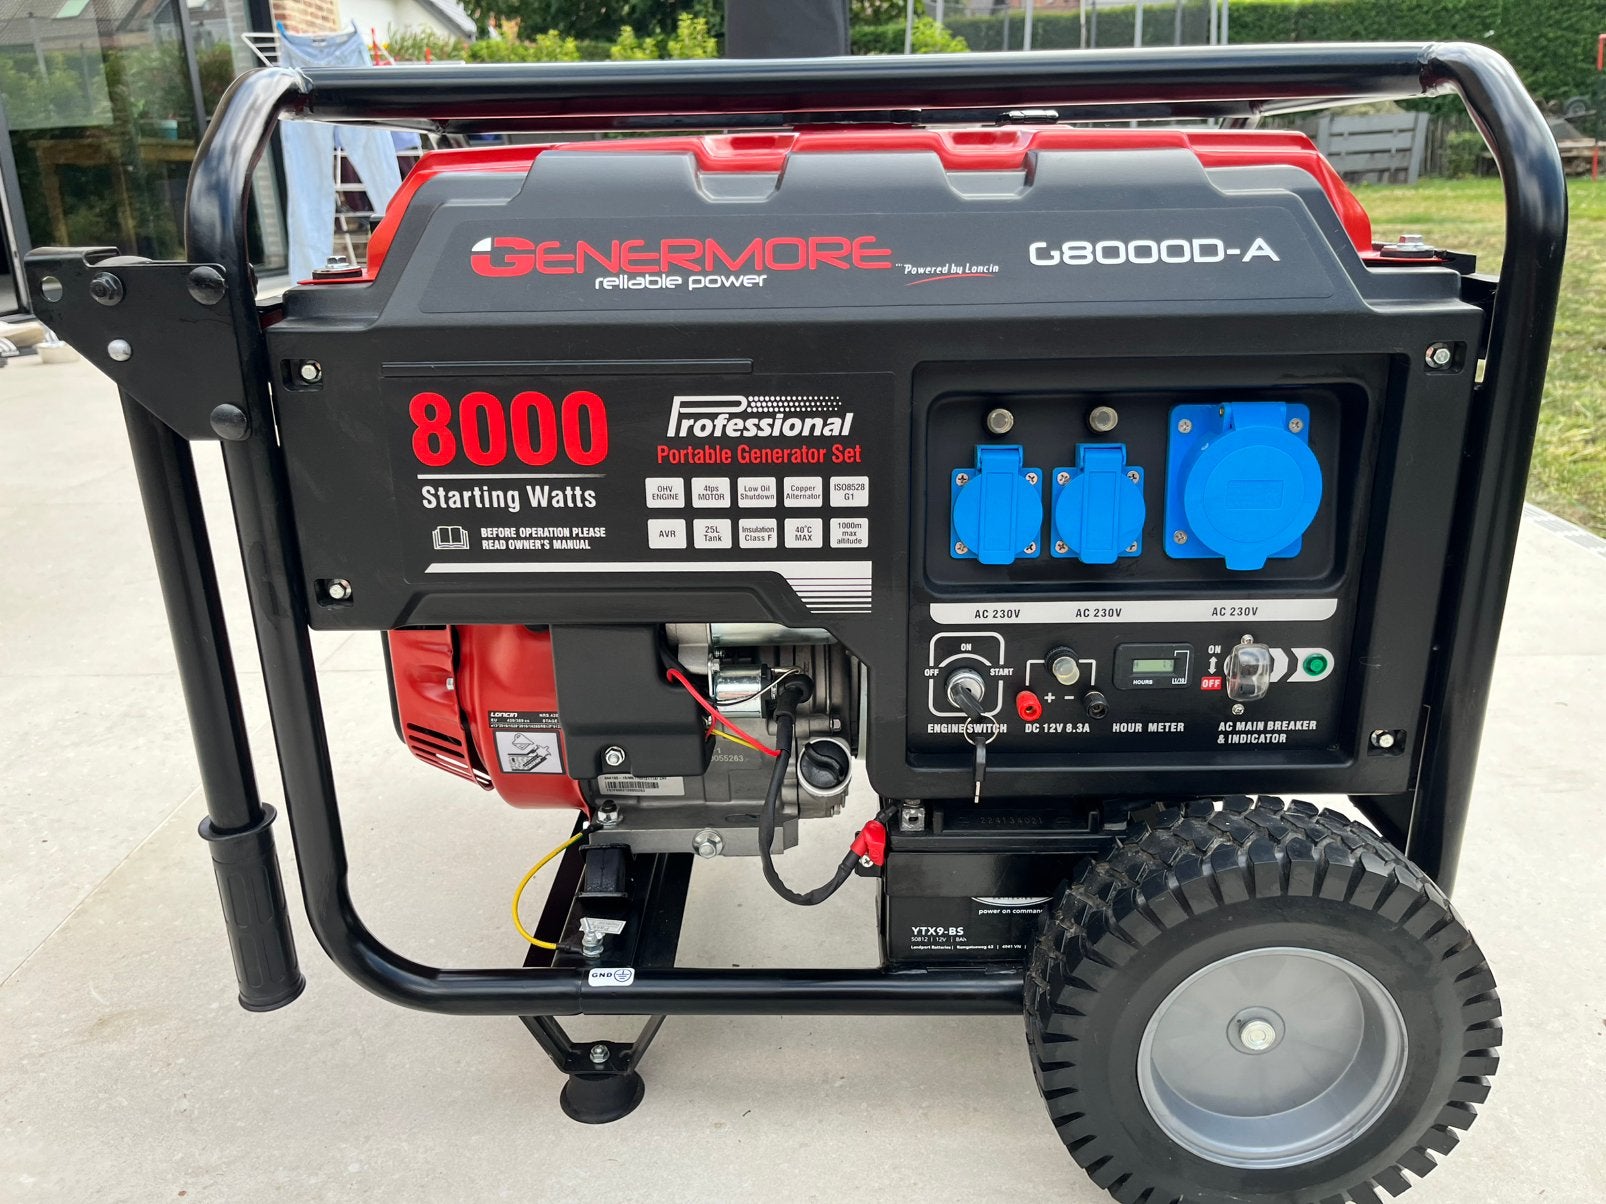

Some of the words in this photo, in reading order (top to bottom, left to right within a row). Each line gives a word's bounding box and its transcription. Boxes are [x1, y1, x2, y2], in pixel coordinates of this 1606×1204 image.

[471, 235, 892, 278] GENERMORE
[1028, 237, 1281, 267] G8000D-A
[903, 262, 949, 275] Powered
[950, 262, 963, 274] by
[965, 261, 999, 273] Loncin
[595, 274, 682, 290] reliable
[688, 274, 767, 291] power
[667, 395, 854, 437] Professional
[409, 390, 609, 467] 8000
[657, 445, 732, 464] Portable
[737, 444, 827, 464] Generator
[831, 444, 862, 464] Set
[657, 485, 673, 493] OHV
[743, 485, 759, 493] Low
[761, 484, 771, 493] Oil
[790, 484, 816, 494] Copper
[834, 483, 866, 491] ISO8528
[421, 485, 520, 513] Starting
[526, 485, 597, 509] Watts
[651, 492, 679, 501] ENGINE
[698, 492, 725, 501] MOTOR
[740, 492, 775, 501] Shutdown
[785, 492, 821, 501] Alternator
[844, 492, 855, 501] G1
[705, 525, 720, 534] 25L
[742, 525, 775, 534] Insulation
[837, 522, 862, 530] 1000m
[481, 527, 517, 538] BEFORE
[519, 527, 570, 538] OPERATION
[572, 527, 606, 538] PLEASE
[658, 530, 676, 538] AVR
[703, 534, 723, 542] Tank
[744, 534, 766, 542] Class
[767, 534, 772, 542] F
[794, 534, 813, 542] MAX
[836, 537, 863, 545] altitude
[482, 539, 507, 550] READ
[508, 539, 550, 550] OWNER'S
[553, 539, 591, 549] MANUAL
[974, 609, 989, 619] AC
[992, 609, 1021, 619] 230V
[1075, 608, 1090, 618] AC
[1093, 608, 1122, 618] 230V
[1212, 607, 1228, 617] AC
[1230, 607, 1259, 617] 230V
[960, 643, 972, 651] ON
[1208, 645, 1221, 654] ON
[924, 668, 939, 677] OFF
[990, 668, 1013, 676] START
[1202, 679, 1221, 688] OFF
[927, 723, 965, 733] ENGINE
[966, 723, 1007, 733] SWITCH
[1025, 723, 1041, 733] DC
[1043, 723, 1063, 733] 12V
[1065, 723, 1090, 733] 8.3A
[1112, 723, 1142, 733] HOUR
[1148, 722, 1185, 732] METER
[1218, 722, 1234, 732] AC
[1235, 721, 1263, 731] MAIN
[1266, 720, 1316, 731] BREAKER
[1217, 734, 1225, 744] &
[1228, 733, 1287, 744] INDICATOR
[911, 926, 964, 936] YTX9-BS
